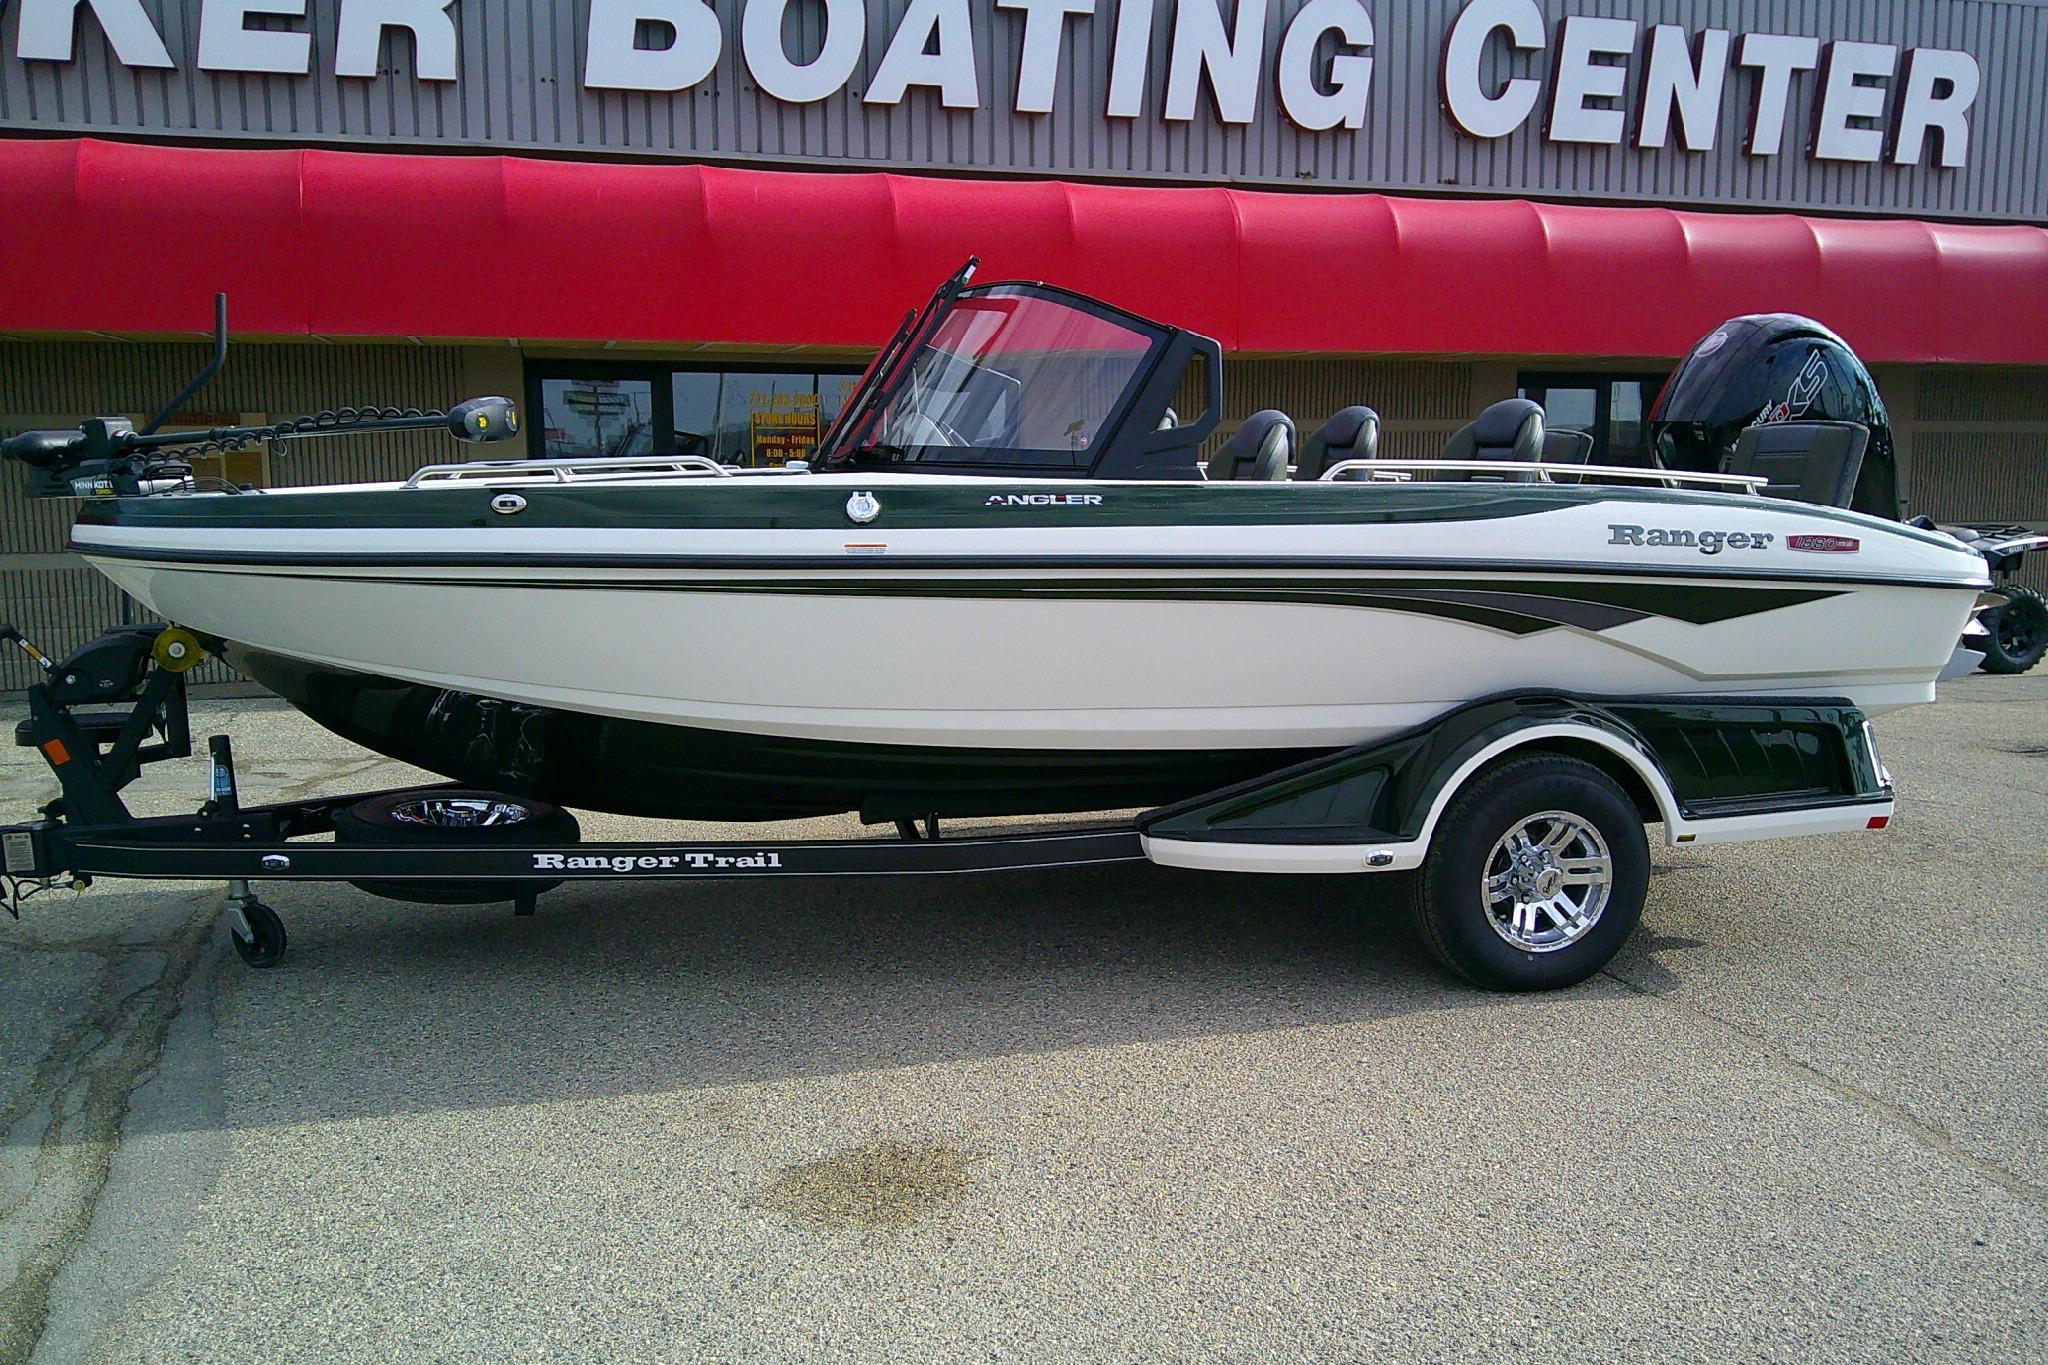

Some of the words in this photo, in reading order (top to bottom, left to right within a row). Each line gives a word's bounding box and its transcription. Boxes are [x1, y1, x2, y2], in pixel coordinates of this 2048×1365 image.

[584, 0, 1374, 131] BOATING
[1444, 0, 1981, 168] CENTER
[784, 412, 816, 425] HOURS
[756, 434, 785, 446] Monday
[791, 434, 815, 446] Friday
[766, 448, 783, 458] 8:00
[789, 448, 806, 458] 5:00
[985, 494, 1103, 506] ANGLER
[1607, 524, 1774, 555] Ranger
[533, 853, 680, 872] Ranger
[685, 852, 782, 868] Trail
